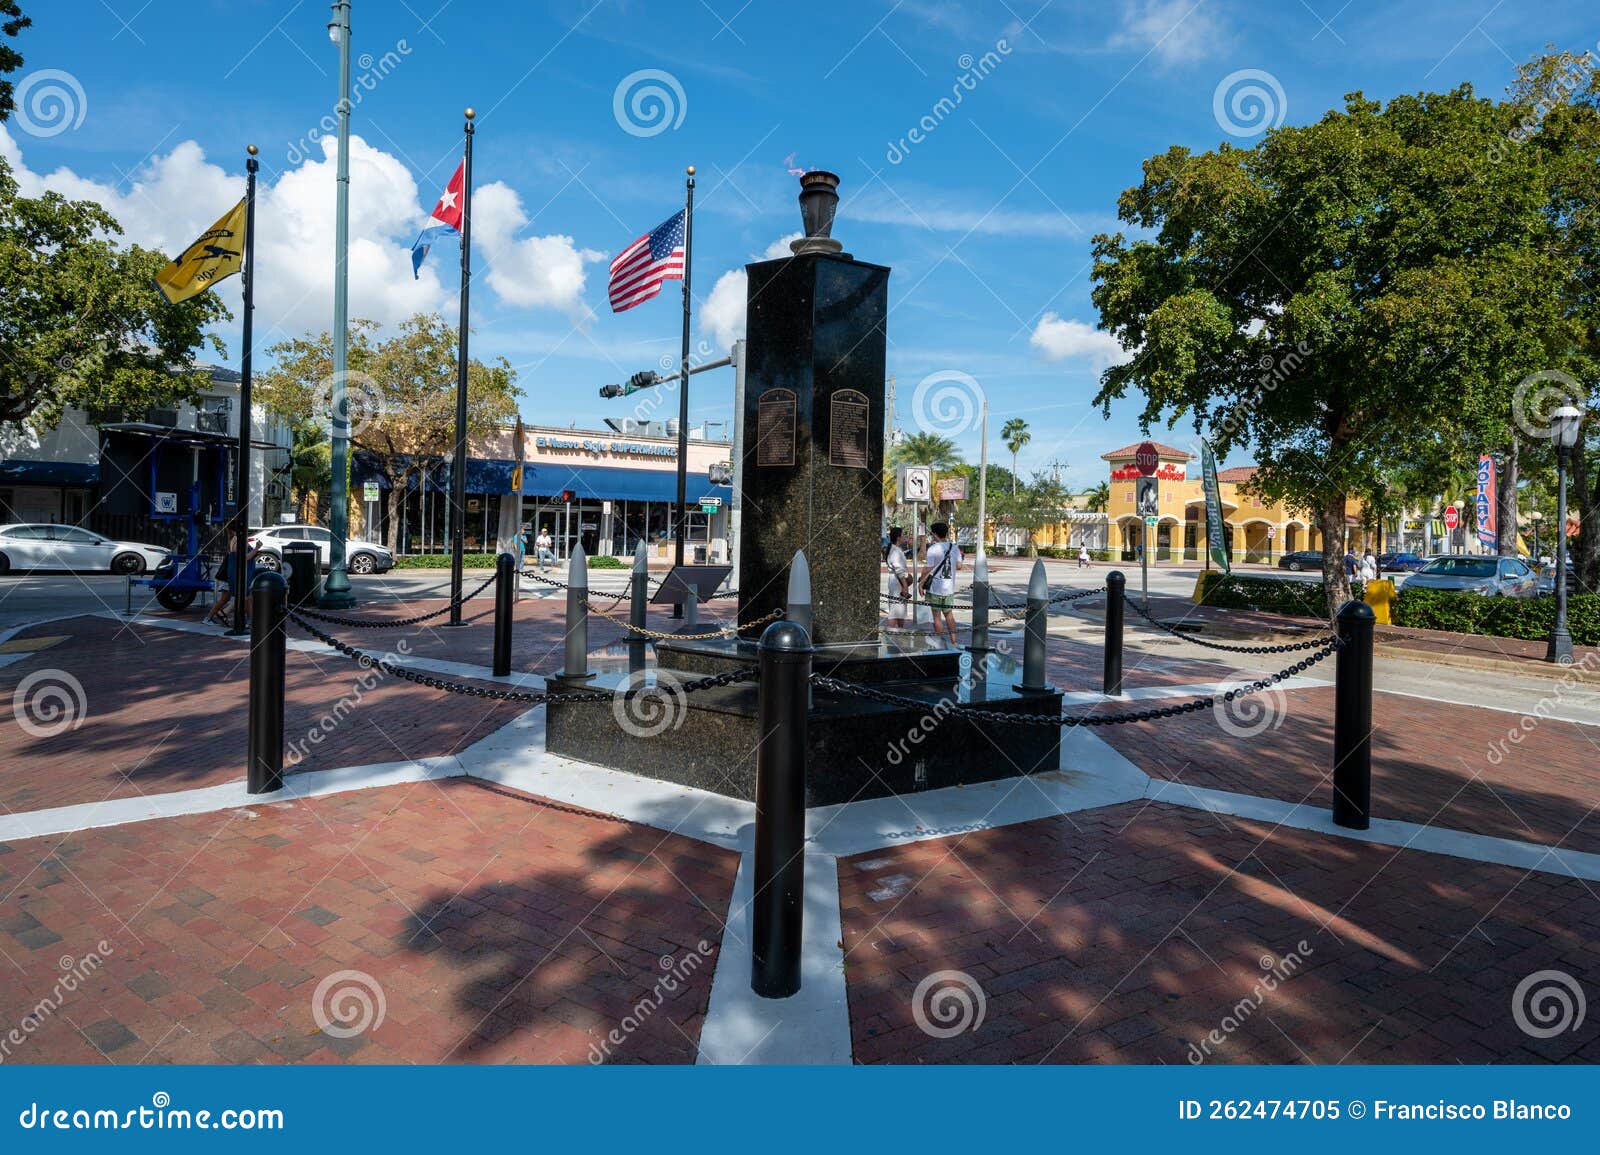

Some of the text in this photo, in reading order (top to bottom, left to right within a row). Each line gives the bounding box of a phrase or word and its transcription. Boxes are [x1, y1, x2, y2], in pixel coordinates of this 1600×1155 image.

[536, 437, 678, 456] El Nuevo Siglo SUPERMARKE
[1137, 453, 1157, 465] STOP
